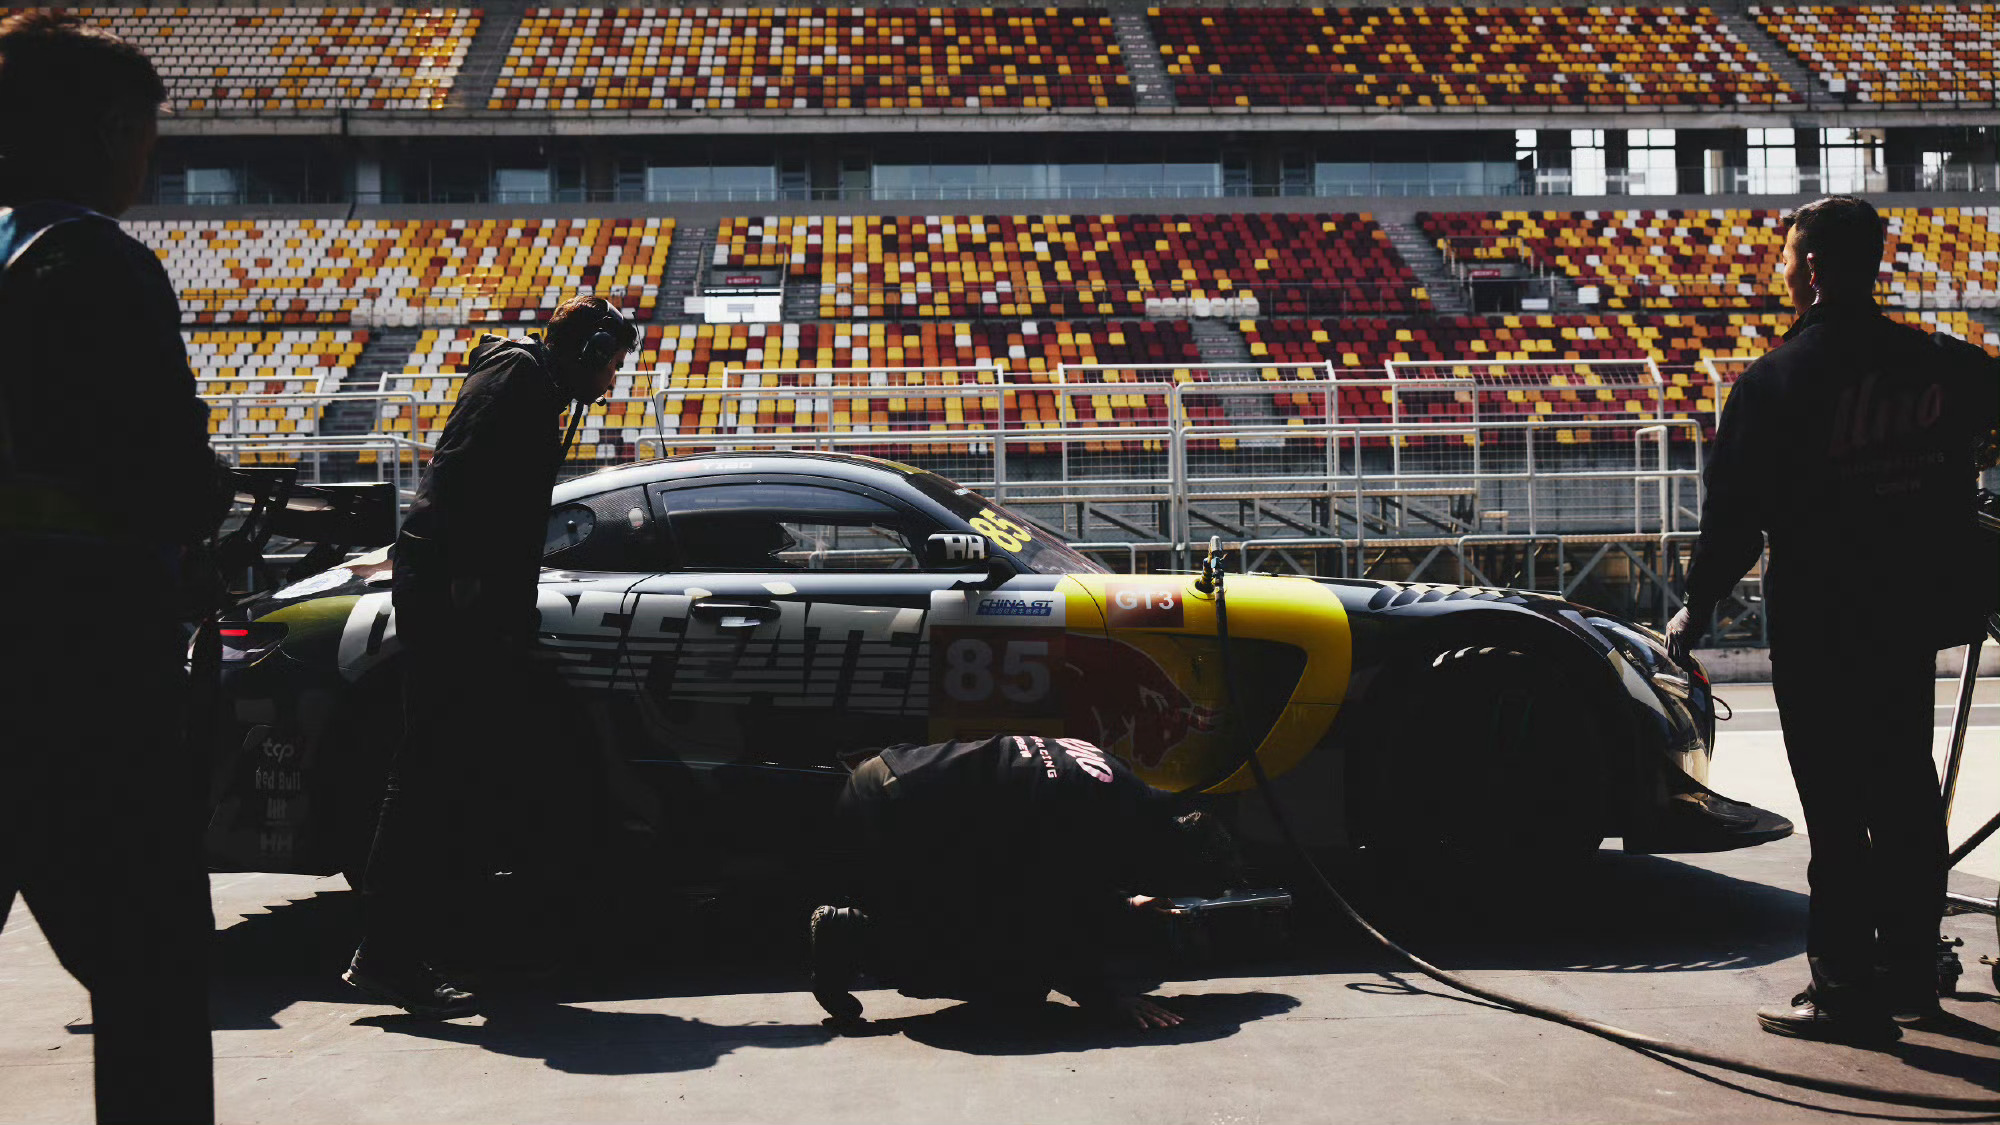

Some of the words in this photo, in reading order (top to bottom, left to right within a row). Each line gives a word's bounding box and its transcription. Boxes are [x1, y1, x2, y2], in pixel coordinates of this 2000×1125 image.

[969, 508, 1032, 553] 85
[979, 599, 1026, 609] CHINA
[1031, 600, 1054, 609] GT
[1115, 590, 1175, 610] GT3
[943, 638, 1051, 703] 85
[255, 769, 275, 791] Red
[278, 771, 301, 791] Bull
